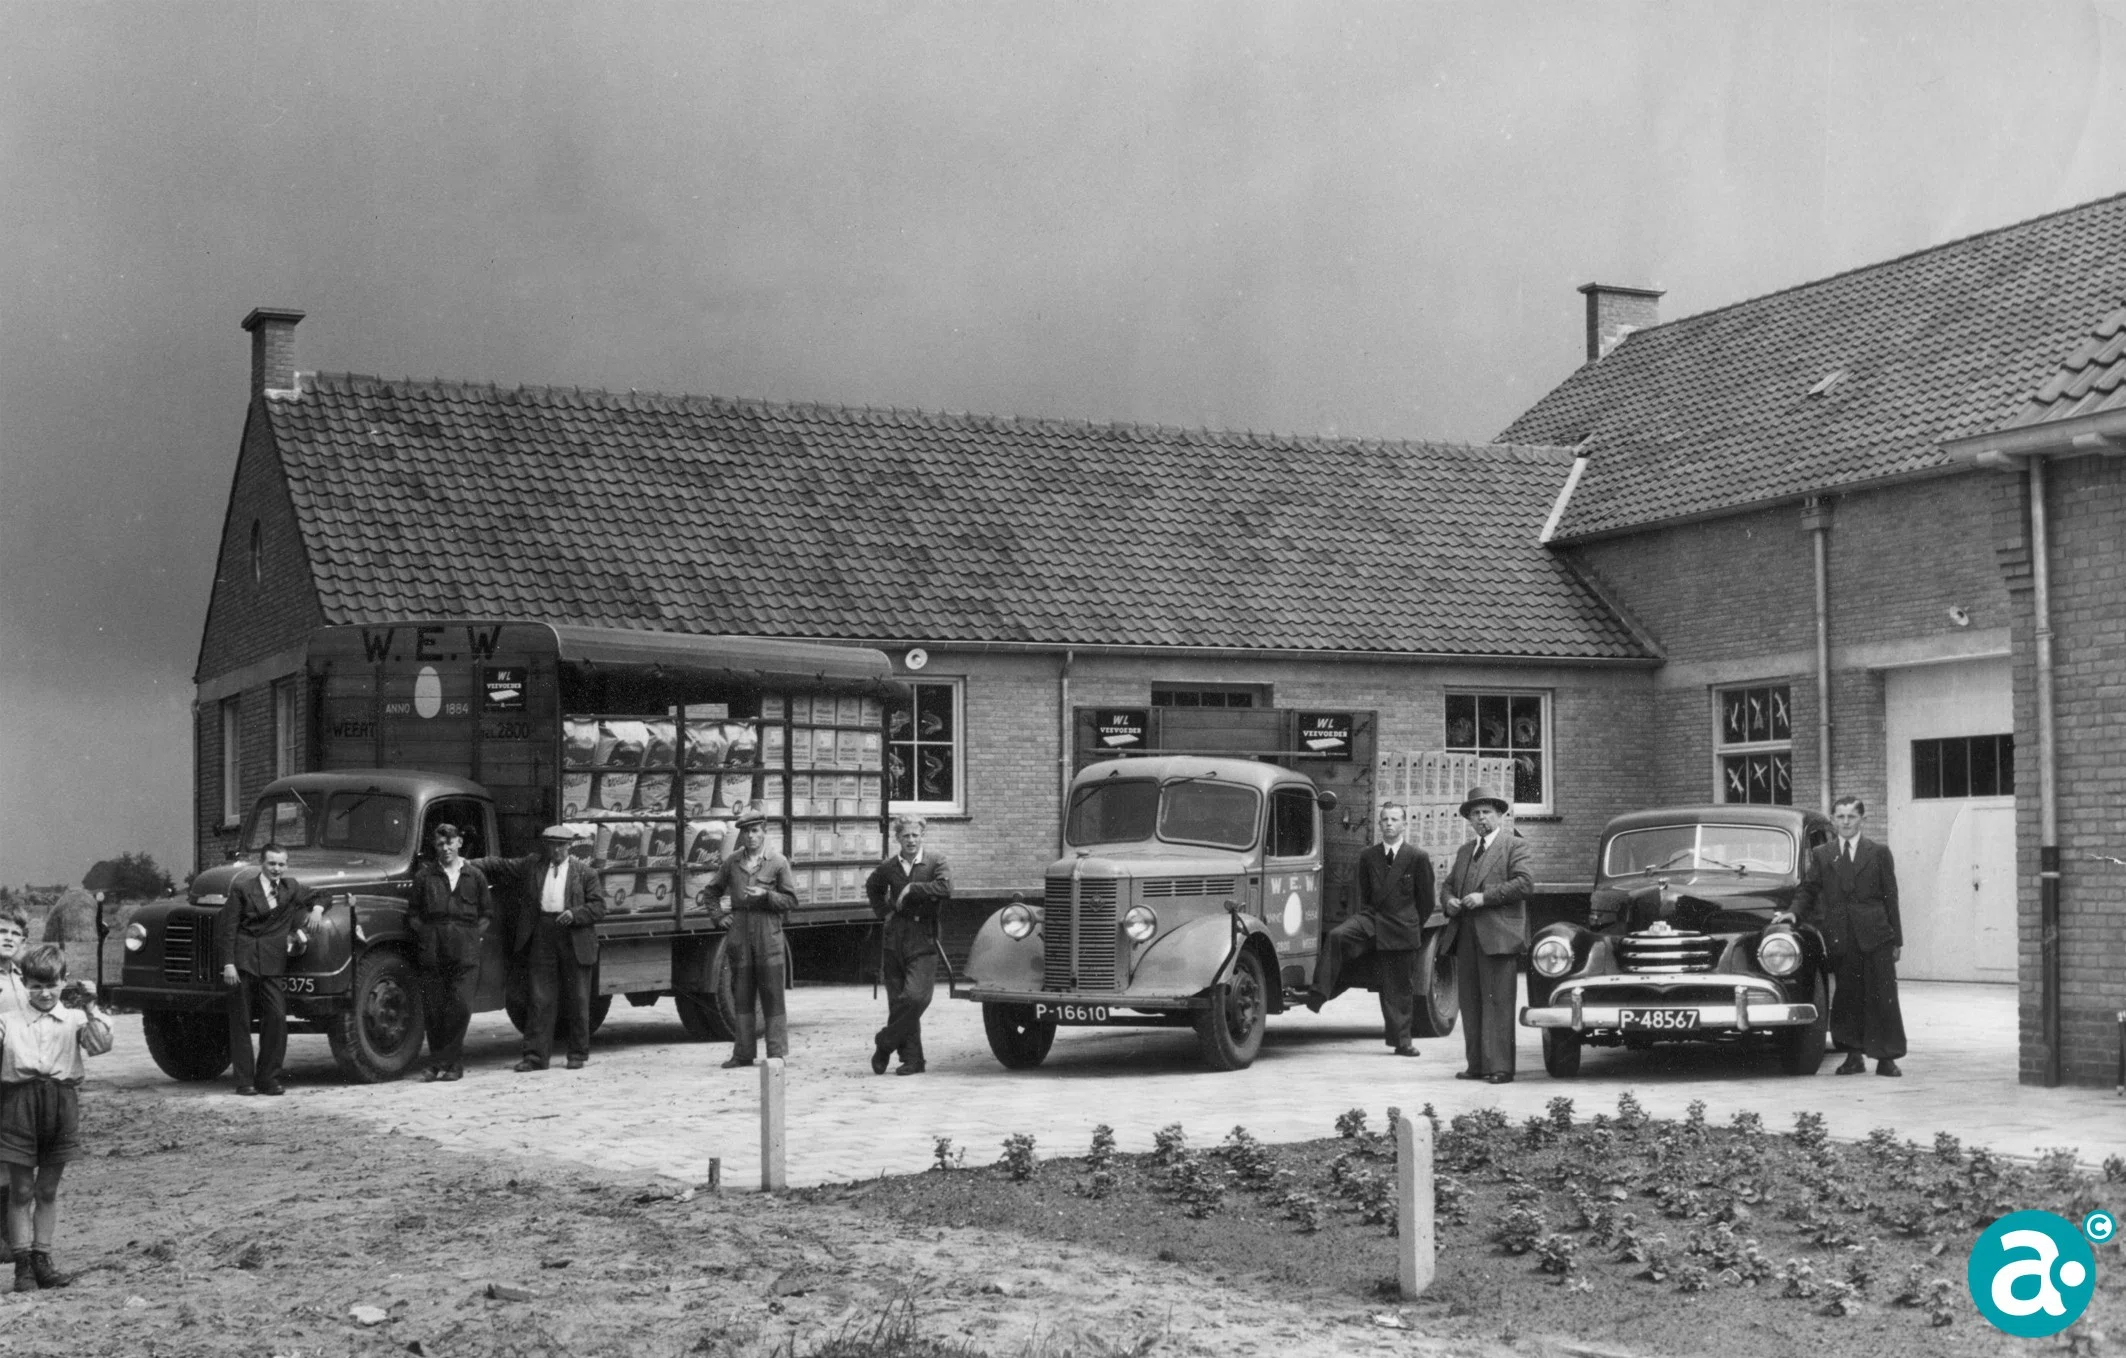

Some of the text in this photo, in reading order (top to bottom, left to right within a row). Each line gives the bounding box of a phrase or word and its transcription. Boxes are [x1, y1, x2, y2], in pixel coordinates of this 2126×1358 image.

[498, 671, 511, 681] WL
[385, 703, 469, 714] ANNO 1884
[1113, 715, 1129, 725] WL
[1317, 718, 1334, 728] WL
[1302, 730, 1348, 738] VEEVOEDER
[1036, 1003, 1107, 1021] P-16610
[1620, 1010, 1698, 1029] P-48567
